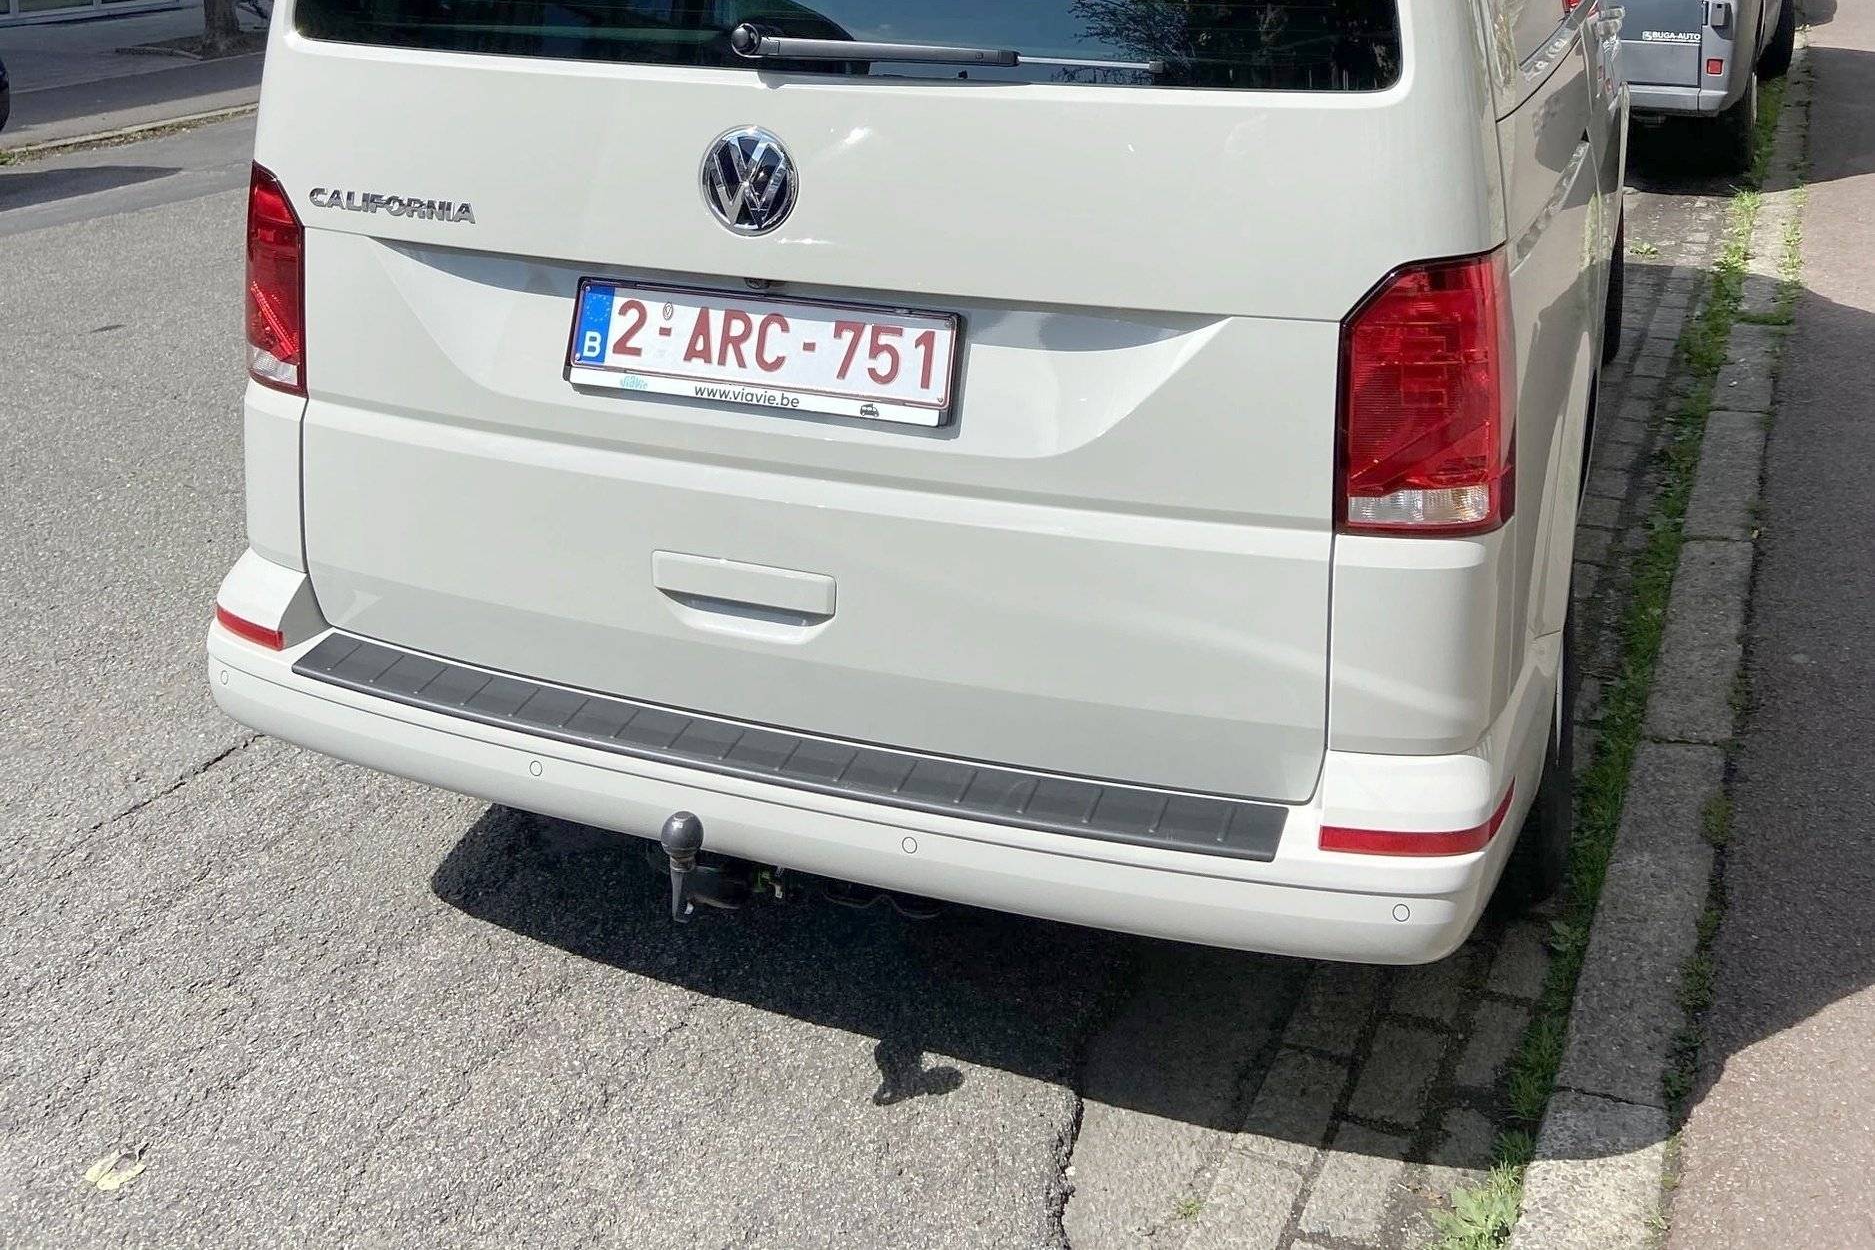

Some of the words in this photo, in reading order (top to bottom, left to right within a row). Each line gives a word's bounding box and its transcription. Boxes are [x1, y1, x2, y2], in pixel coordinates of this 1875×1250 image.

[1652, 31, 1701, 40] BUGA-AUTO
[309, 187, 476, 224] CALIFORNIA
[583, 330, 602, 358] B
[611, 299, 937, 390] 2-ARC-751
[694, 384, 800, 408] www.viavie.be
